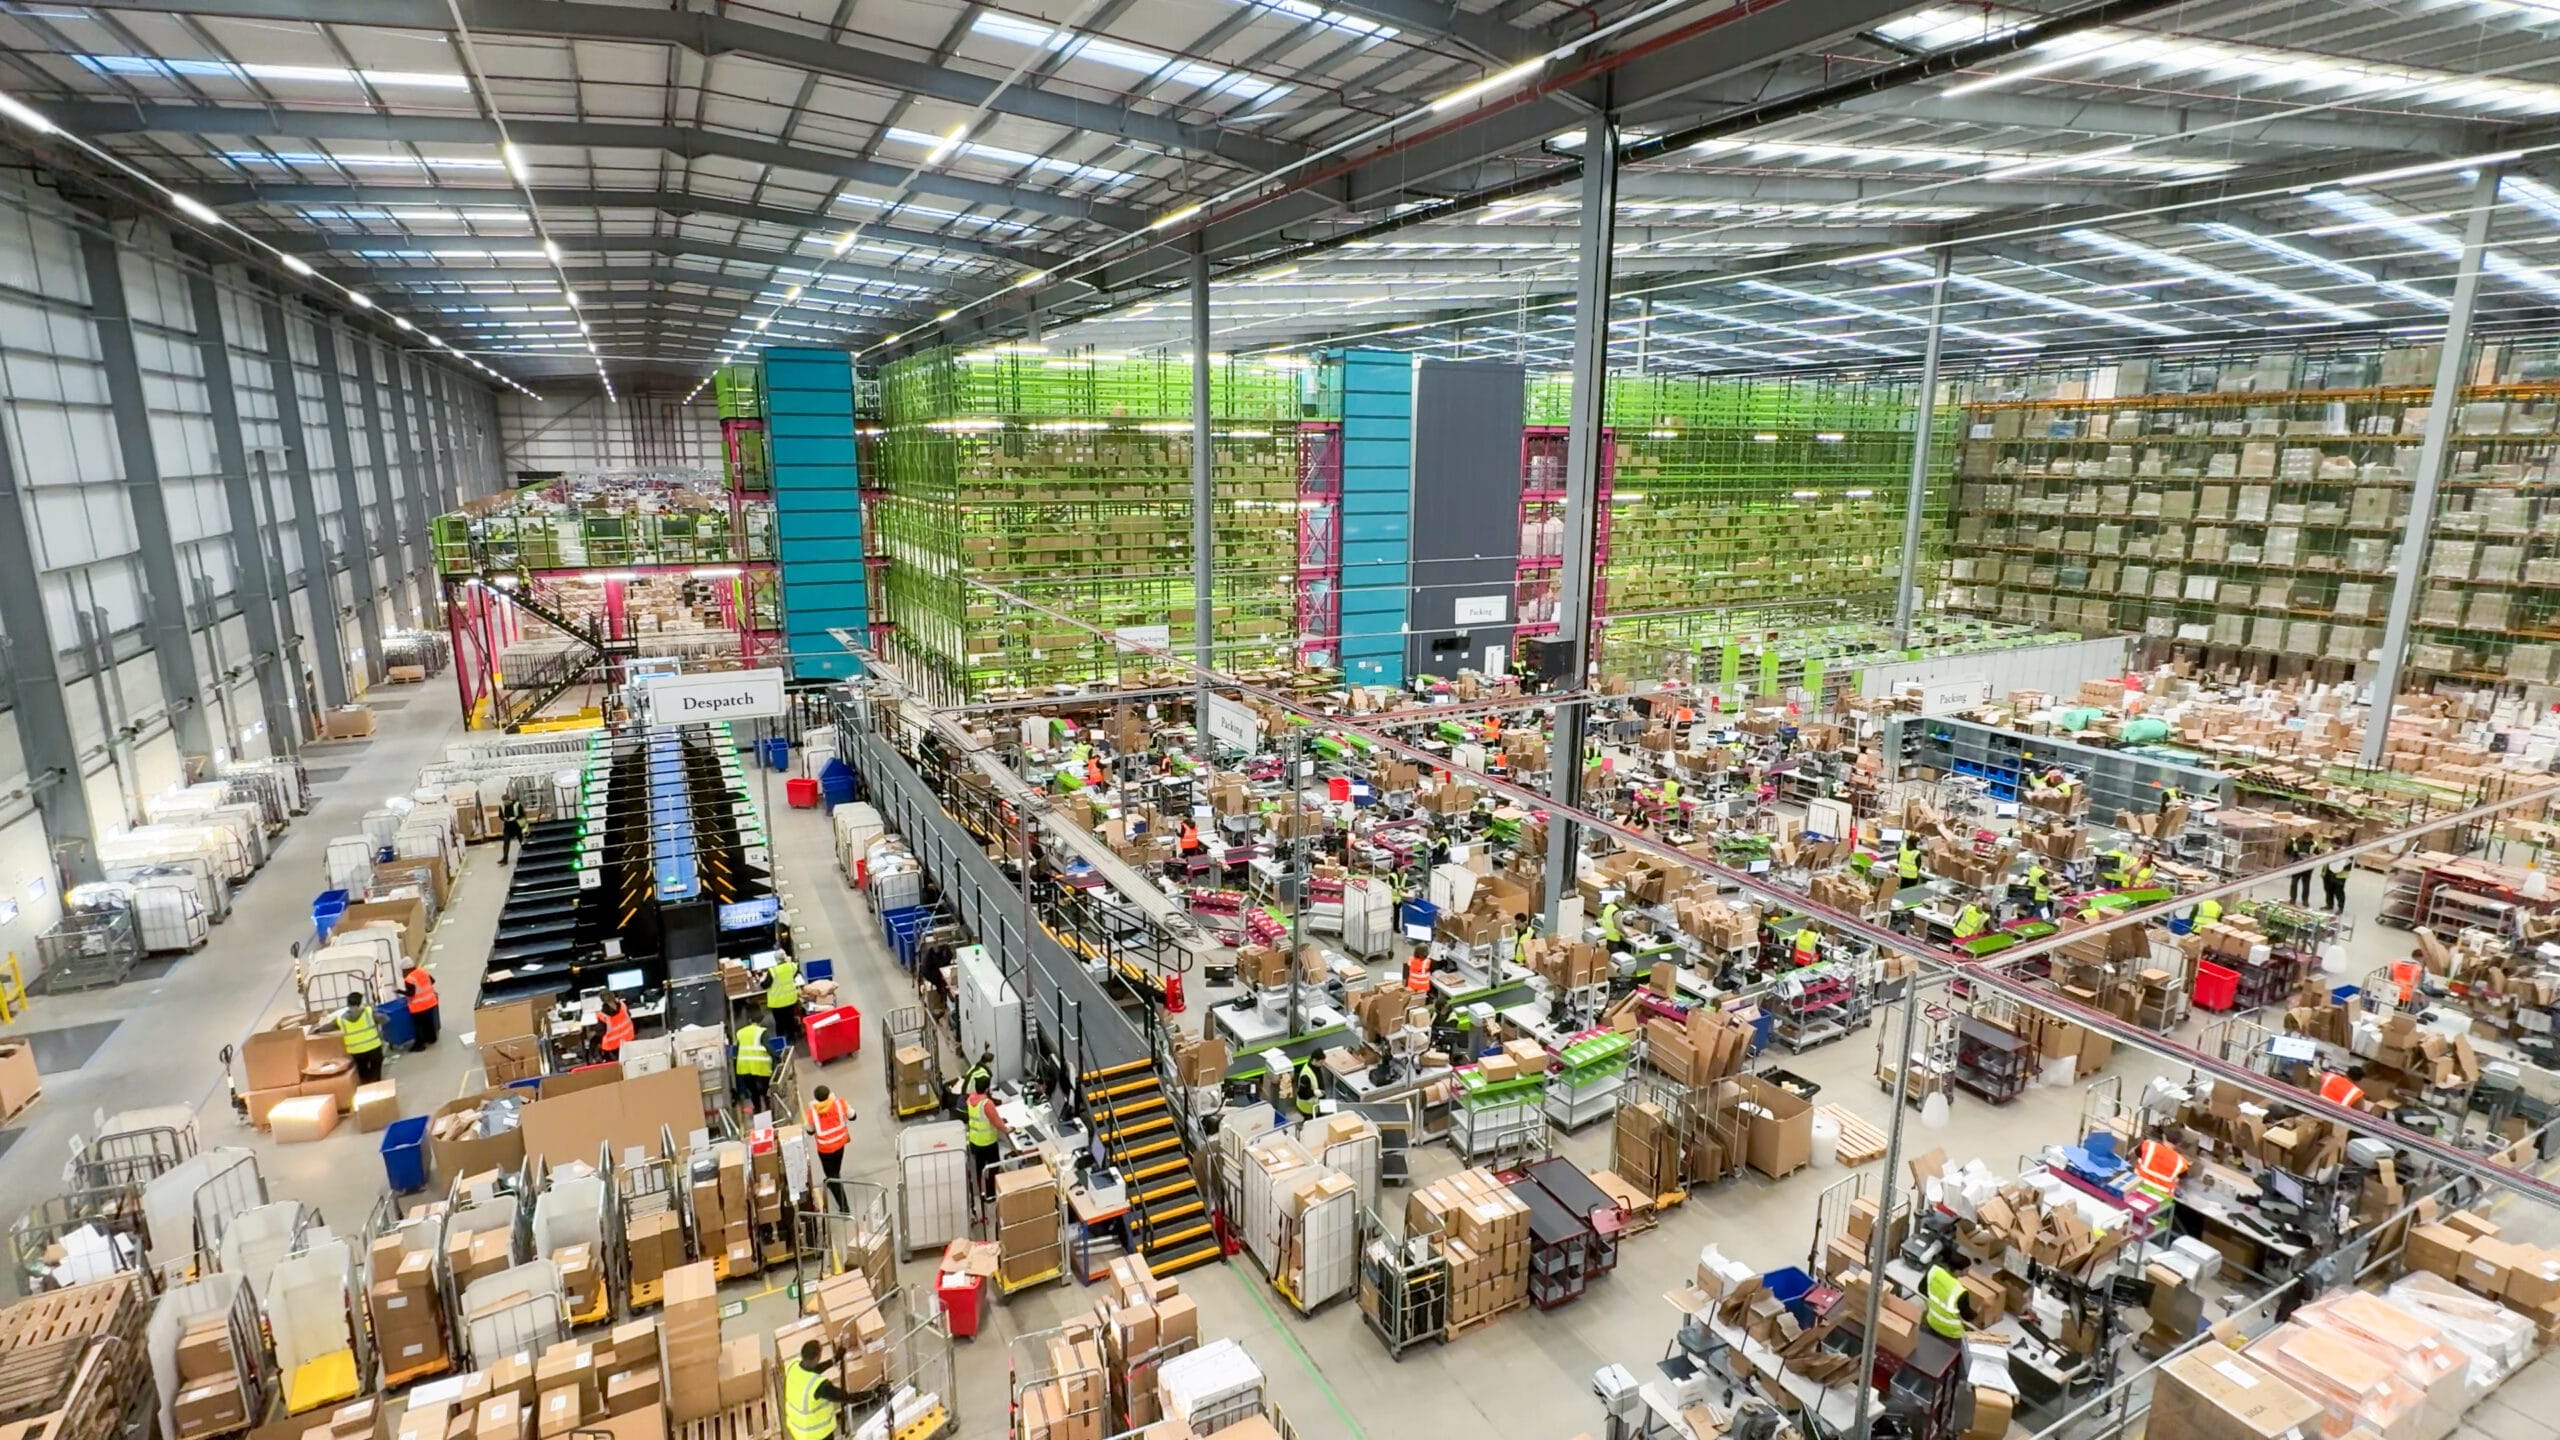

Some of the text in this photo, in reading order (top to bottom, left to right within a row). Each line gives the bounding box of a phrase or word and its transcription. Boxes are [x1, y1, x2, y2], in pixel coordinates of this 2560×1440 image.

[1469, 608, 1492, 616] Packing
[683, 692, 754, 711] Despatch
[1940, 693, 1967, 704] Packing
[1221, 716, 1243, 739] Packing
